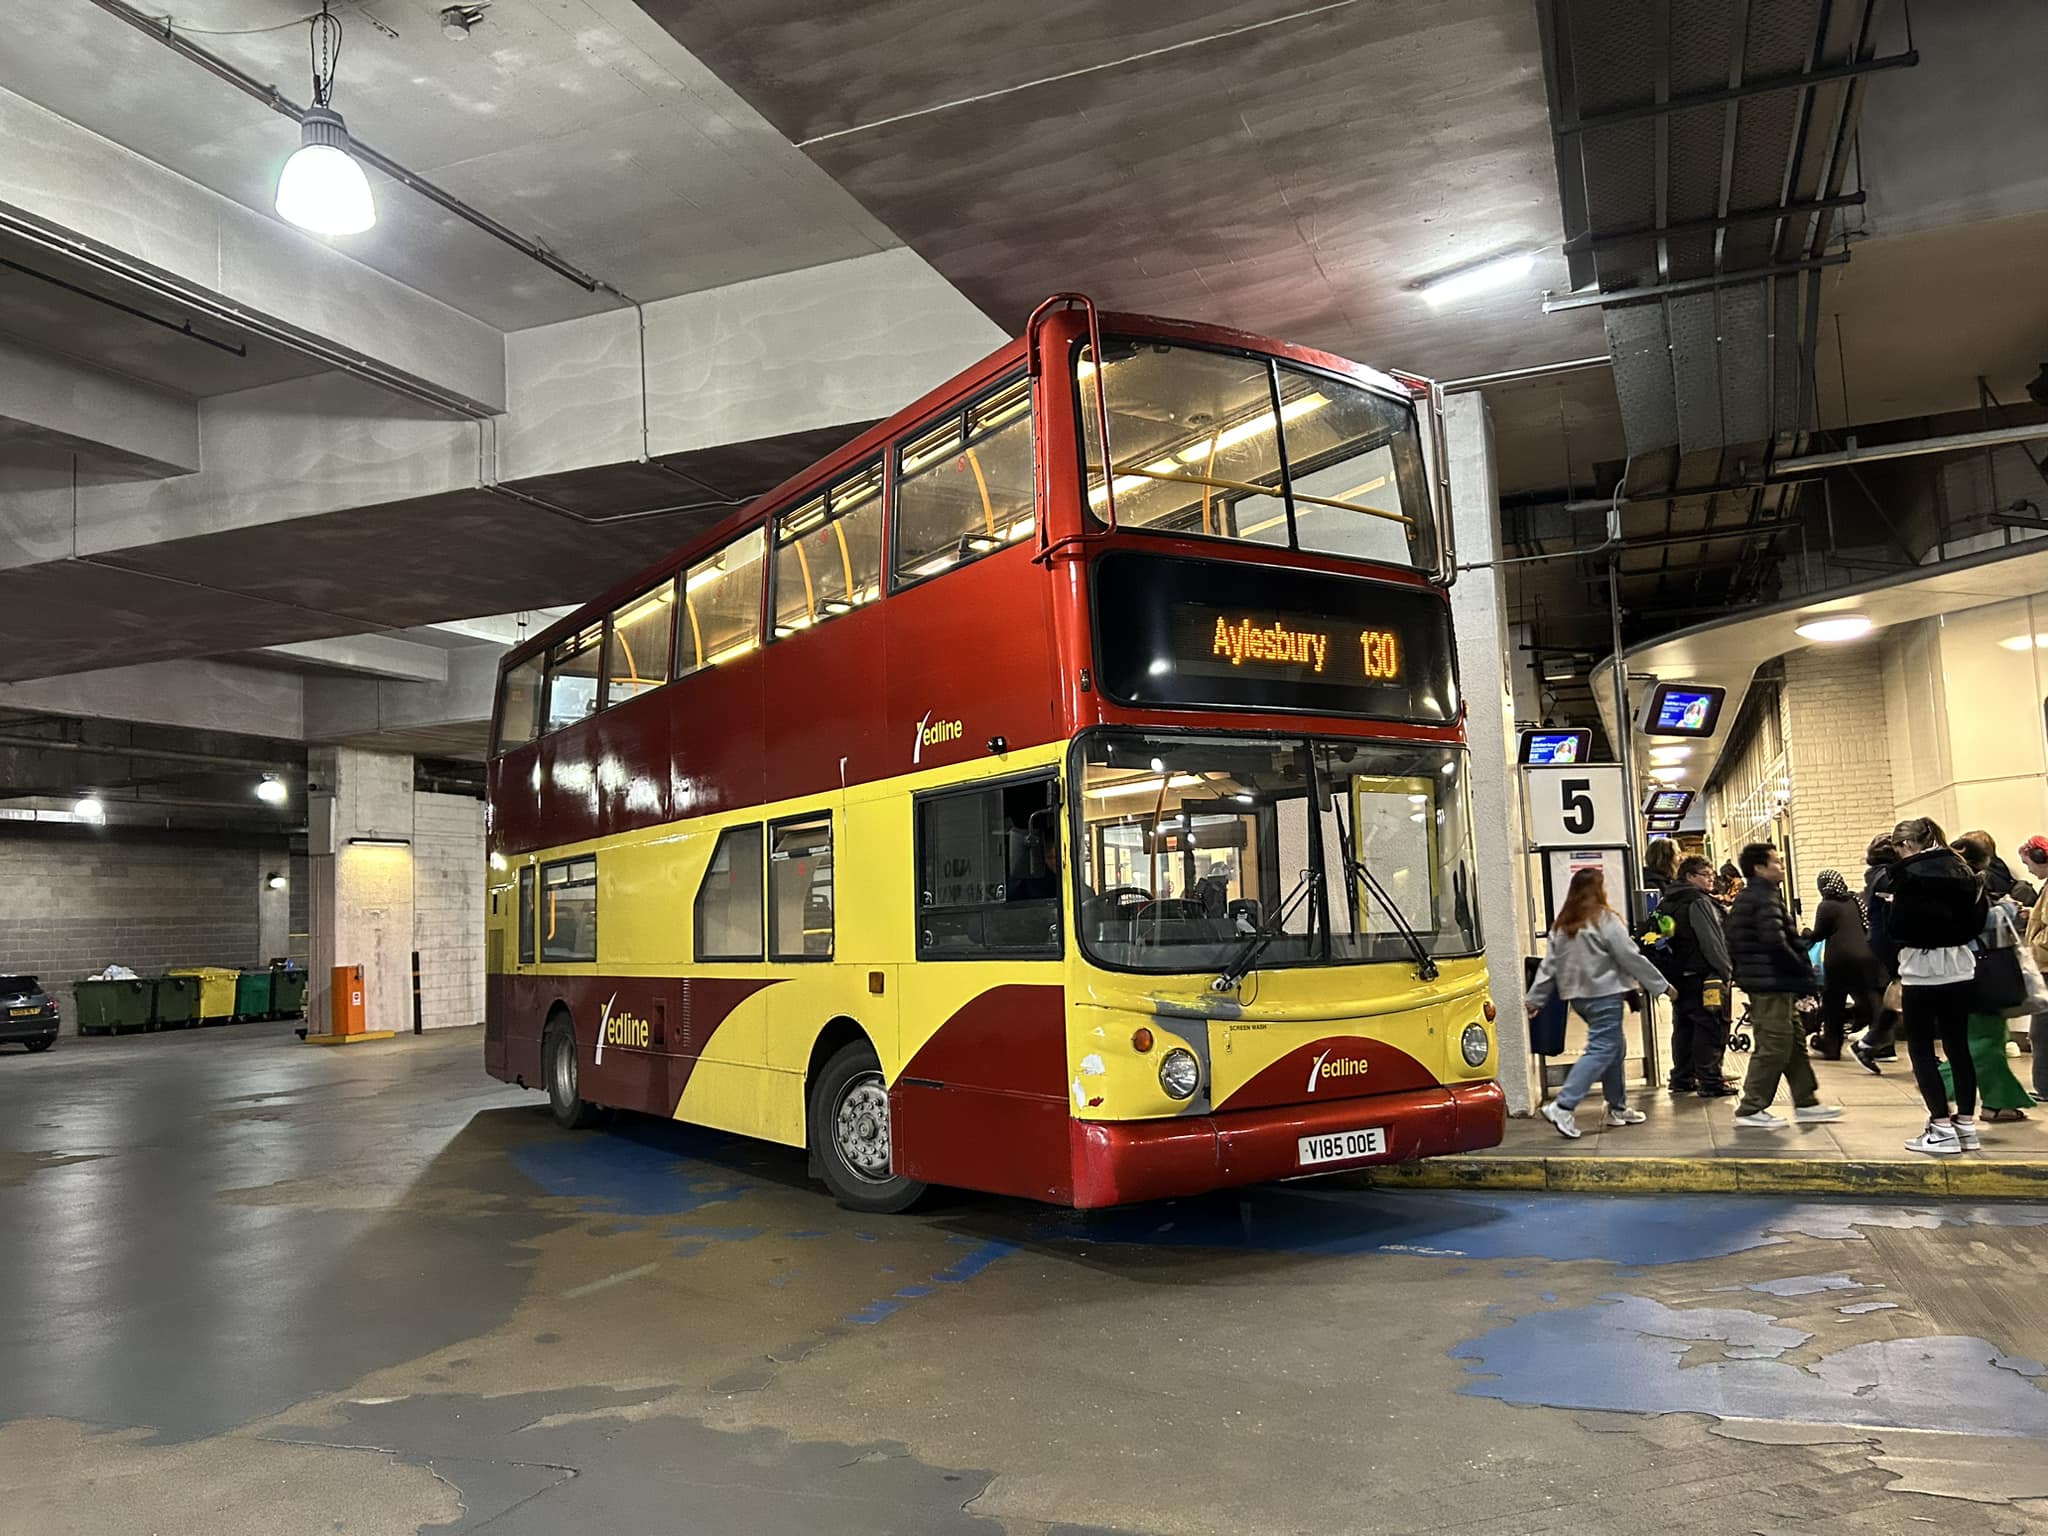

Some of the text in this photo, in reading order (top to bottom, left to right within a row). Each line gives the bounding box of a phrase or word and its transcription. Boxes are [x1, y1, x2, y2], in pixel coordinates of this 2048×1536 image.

[1213, 616, 1398, 678] Aylesbury 130
[1561, 779, 1595, 835] 5
[1308, 1137, 1343, 1160] V185
